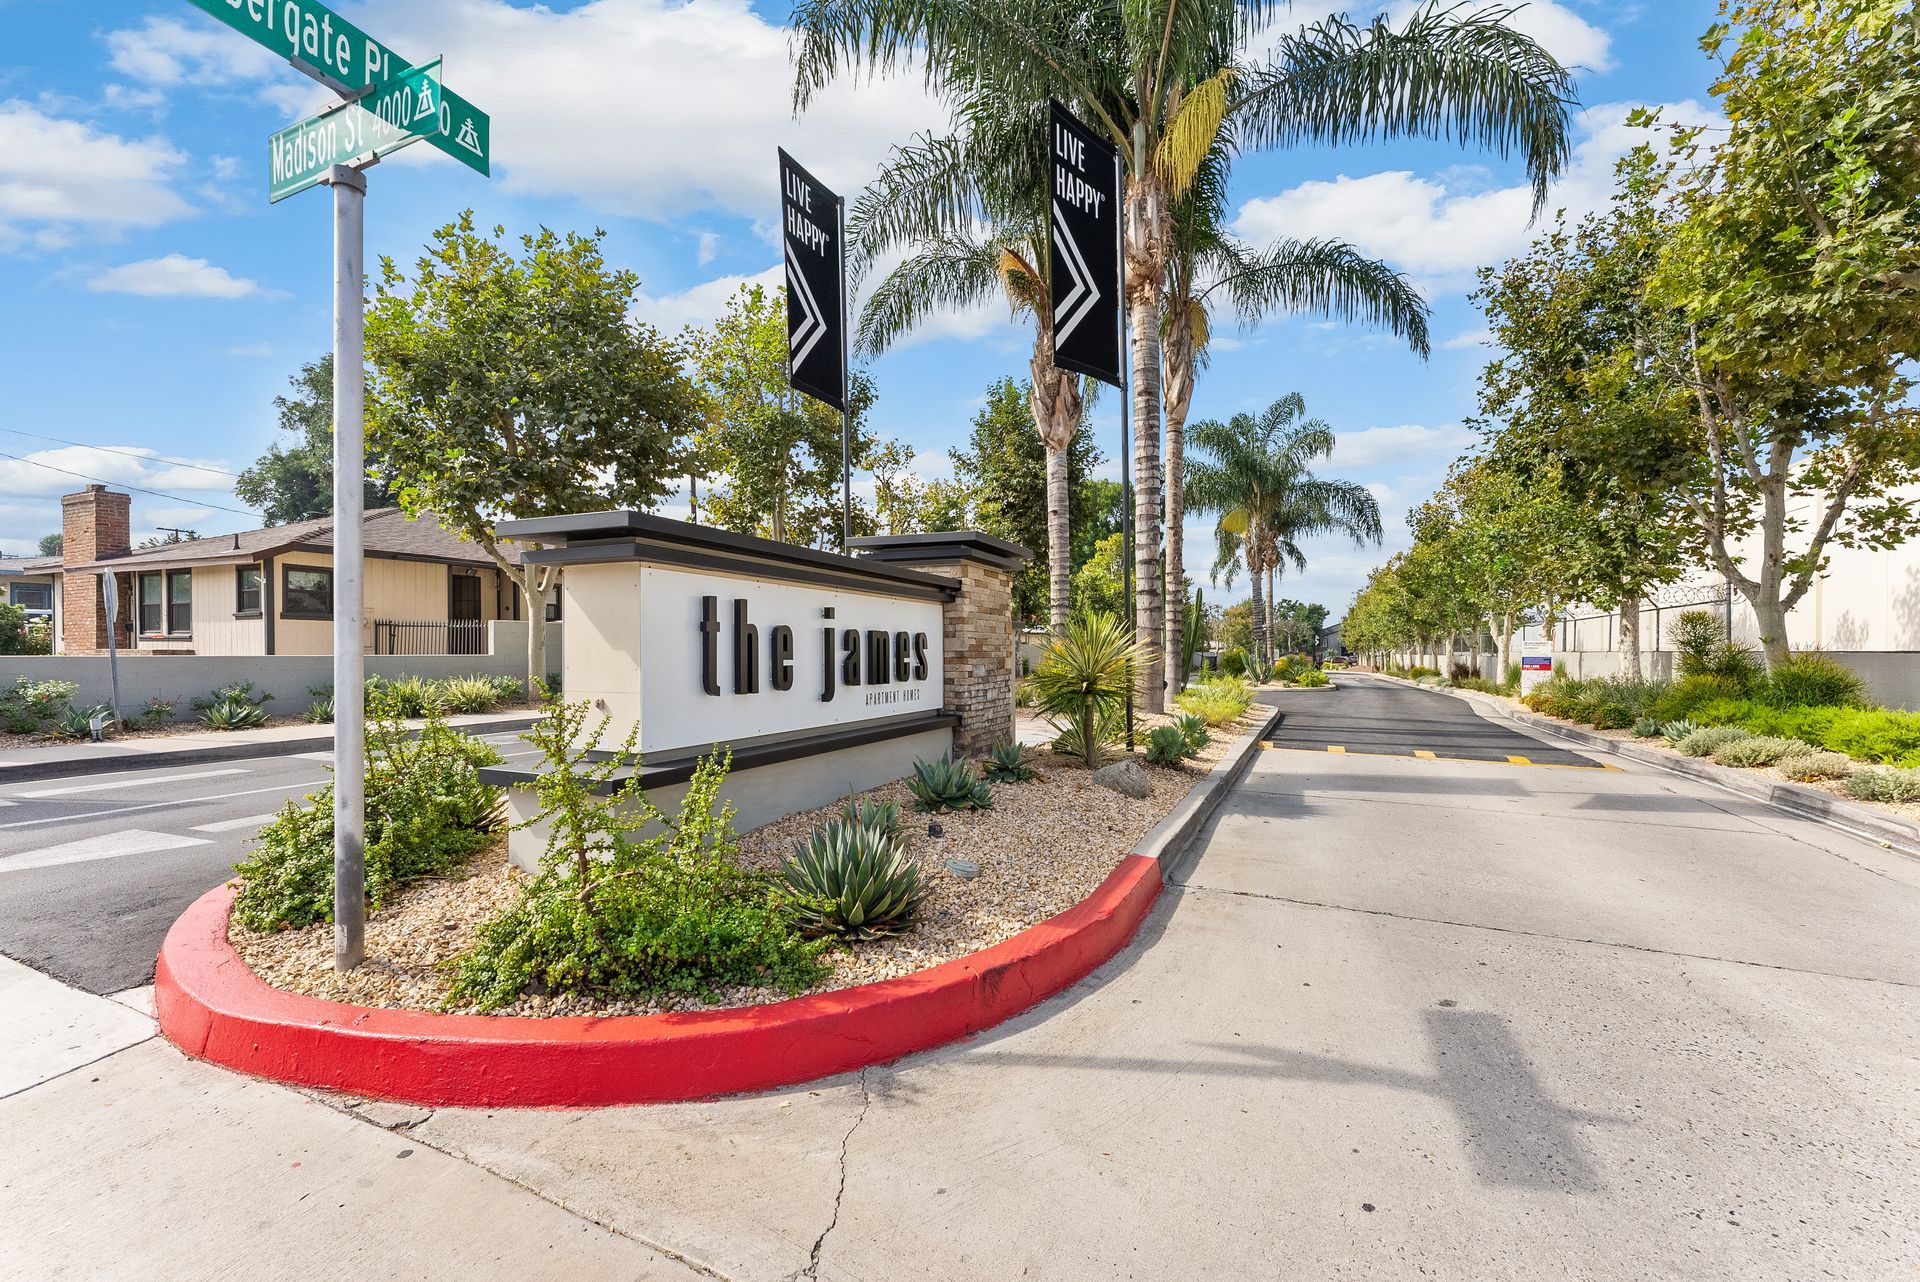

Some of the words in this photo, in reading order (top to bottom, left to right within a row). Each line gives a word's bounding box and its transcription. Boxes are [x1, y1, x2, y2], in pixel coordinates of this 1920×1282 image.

[225, 0, 351, 76] ergate
[364, 39, 389, 85] Pl
[272, 120, 337, 185] Madison
[344, 98, 364, 153] St
[372, 85, 412, 139] 4000
[1056, 122, 1085, 172] LIVE
[786, 167, 812, 214] LIVE
[700, 595, 794, 696] the
[820, 606, 929, 702] james
[865, 690, 900, 707] APARTMENT
[903, 688, 920, 701] HOMES
